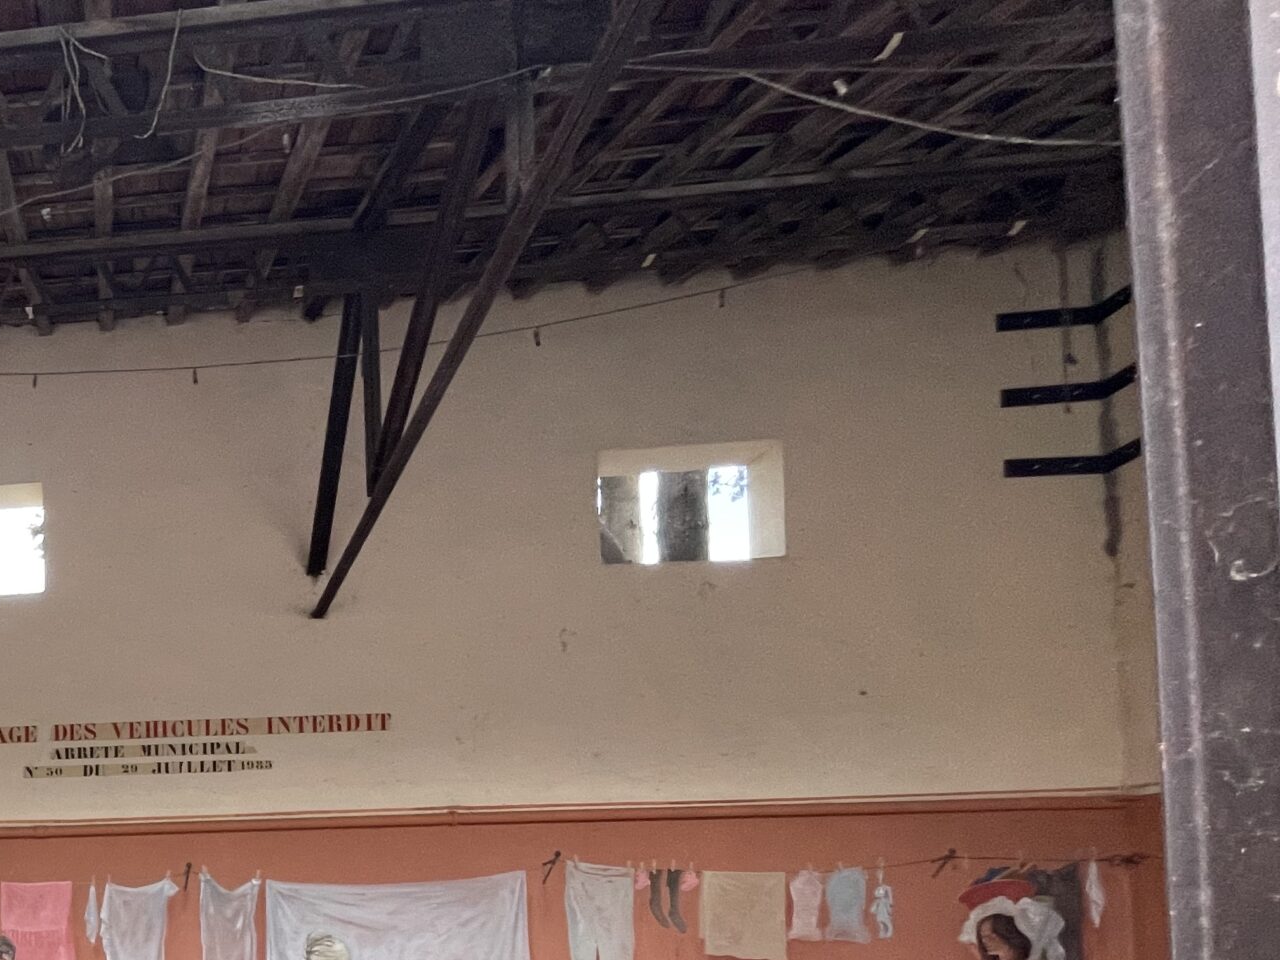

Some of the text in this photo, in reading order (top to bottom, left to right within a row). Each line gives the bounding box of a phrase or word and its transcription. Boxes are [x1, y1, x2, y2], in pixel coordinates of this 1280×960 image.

[53, 723, 97, 741] DES
[112, 719, 249, 740] VEHICULES
[267, 713, 392, 733] INTERDIT
[52, 741, 246, 760] ARRETE MUNICIPAL
[46, 767, 63, 777] 50
[121, 764, 138, 773] 29
[152, 760, 236, 774] JUILLET
